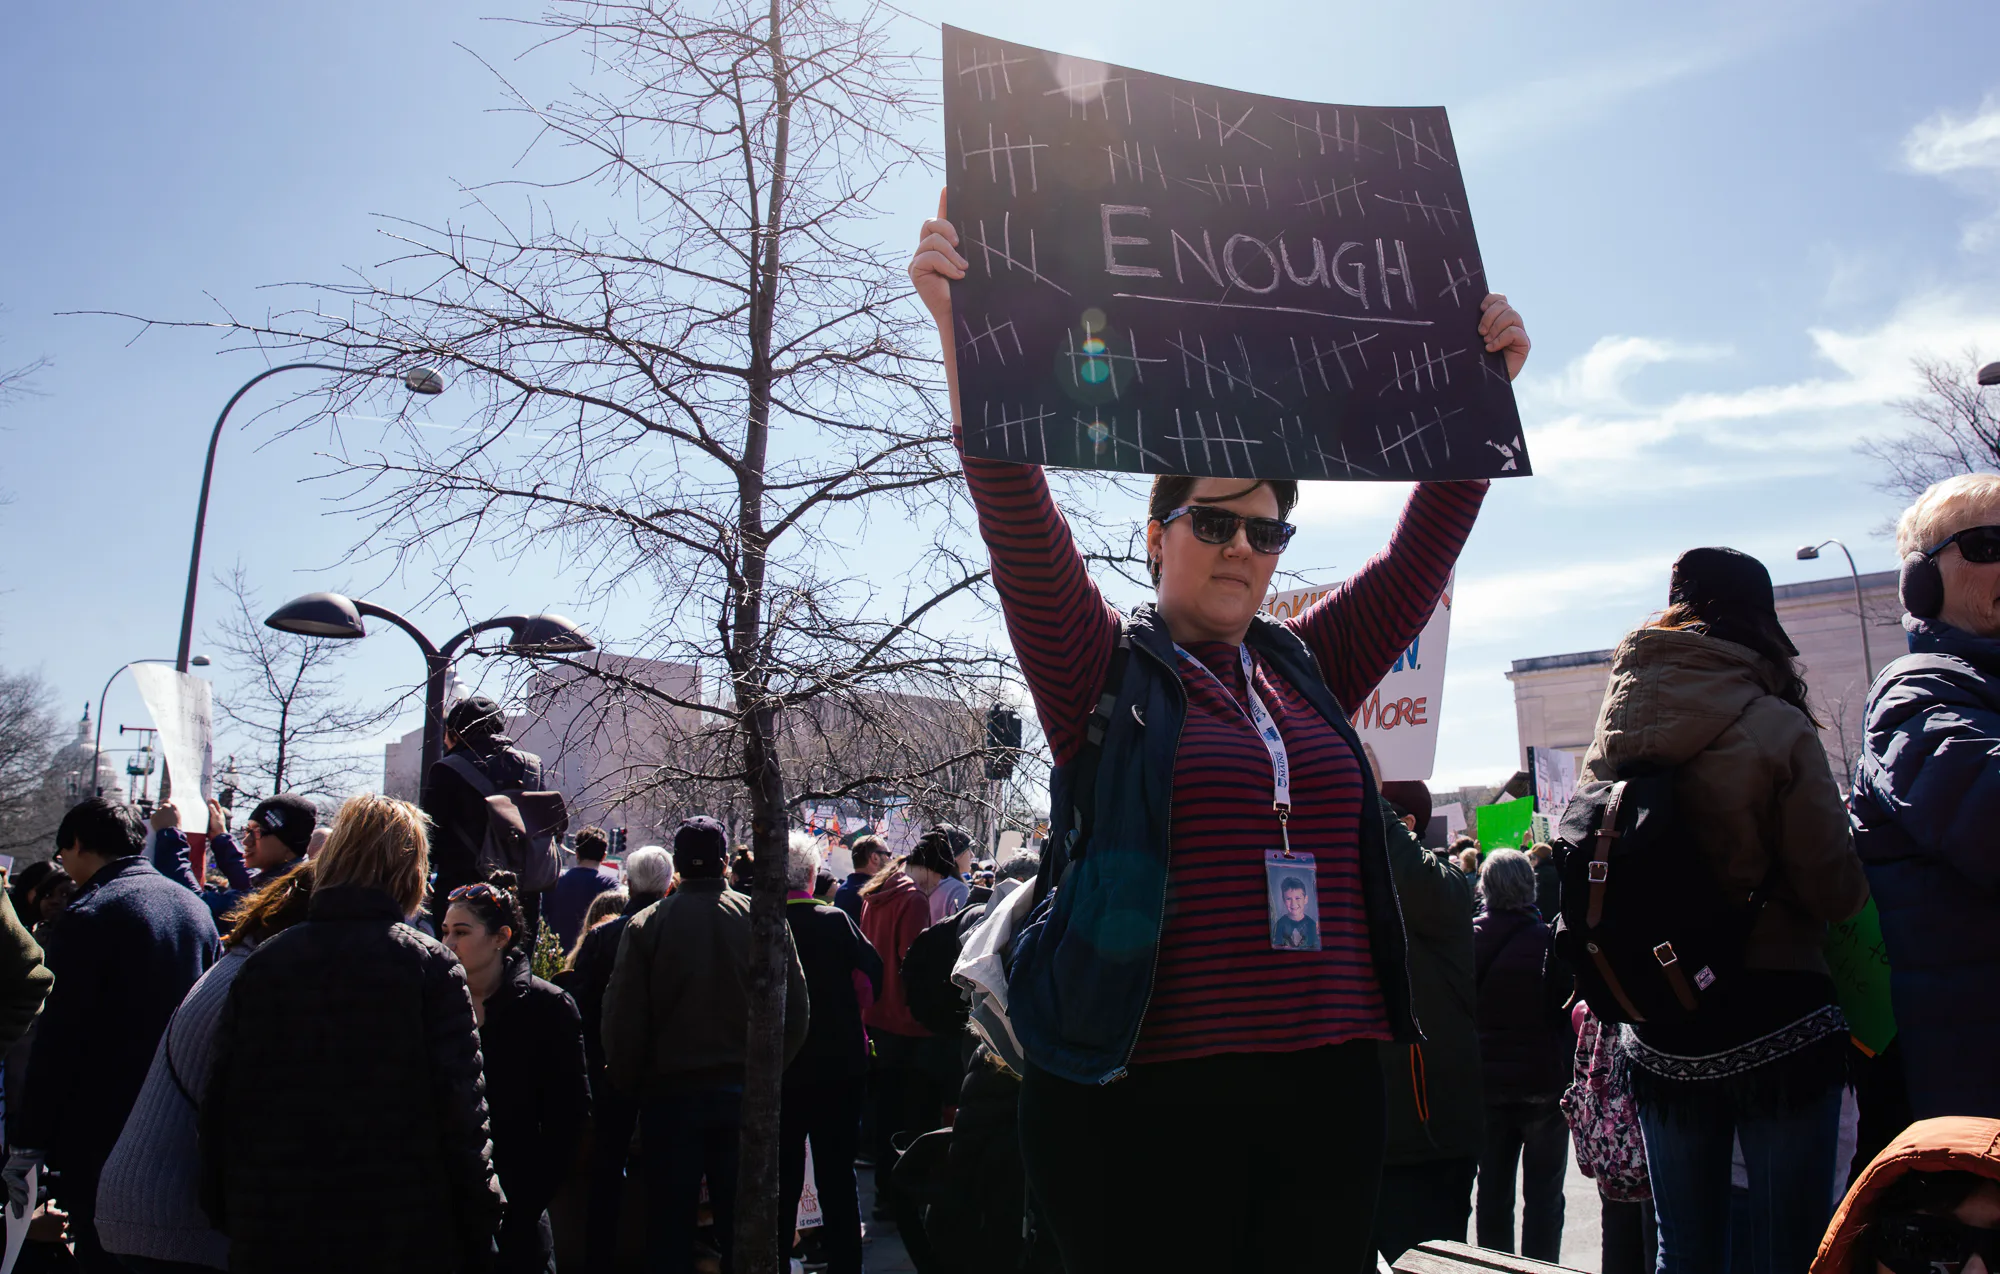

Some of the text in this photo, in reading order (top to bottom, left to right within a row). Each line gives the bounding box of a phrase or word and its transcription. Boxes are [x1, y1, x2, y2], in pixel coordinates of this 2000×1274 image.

[1099, 203, 1418, 311] ENOUGH
[1352, 688, 1428, 730] MORE
[1277, 751, 1287, 778] MAINE
